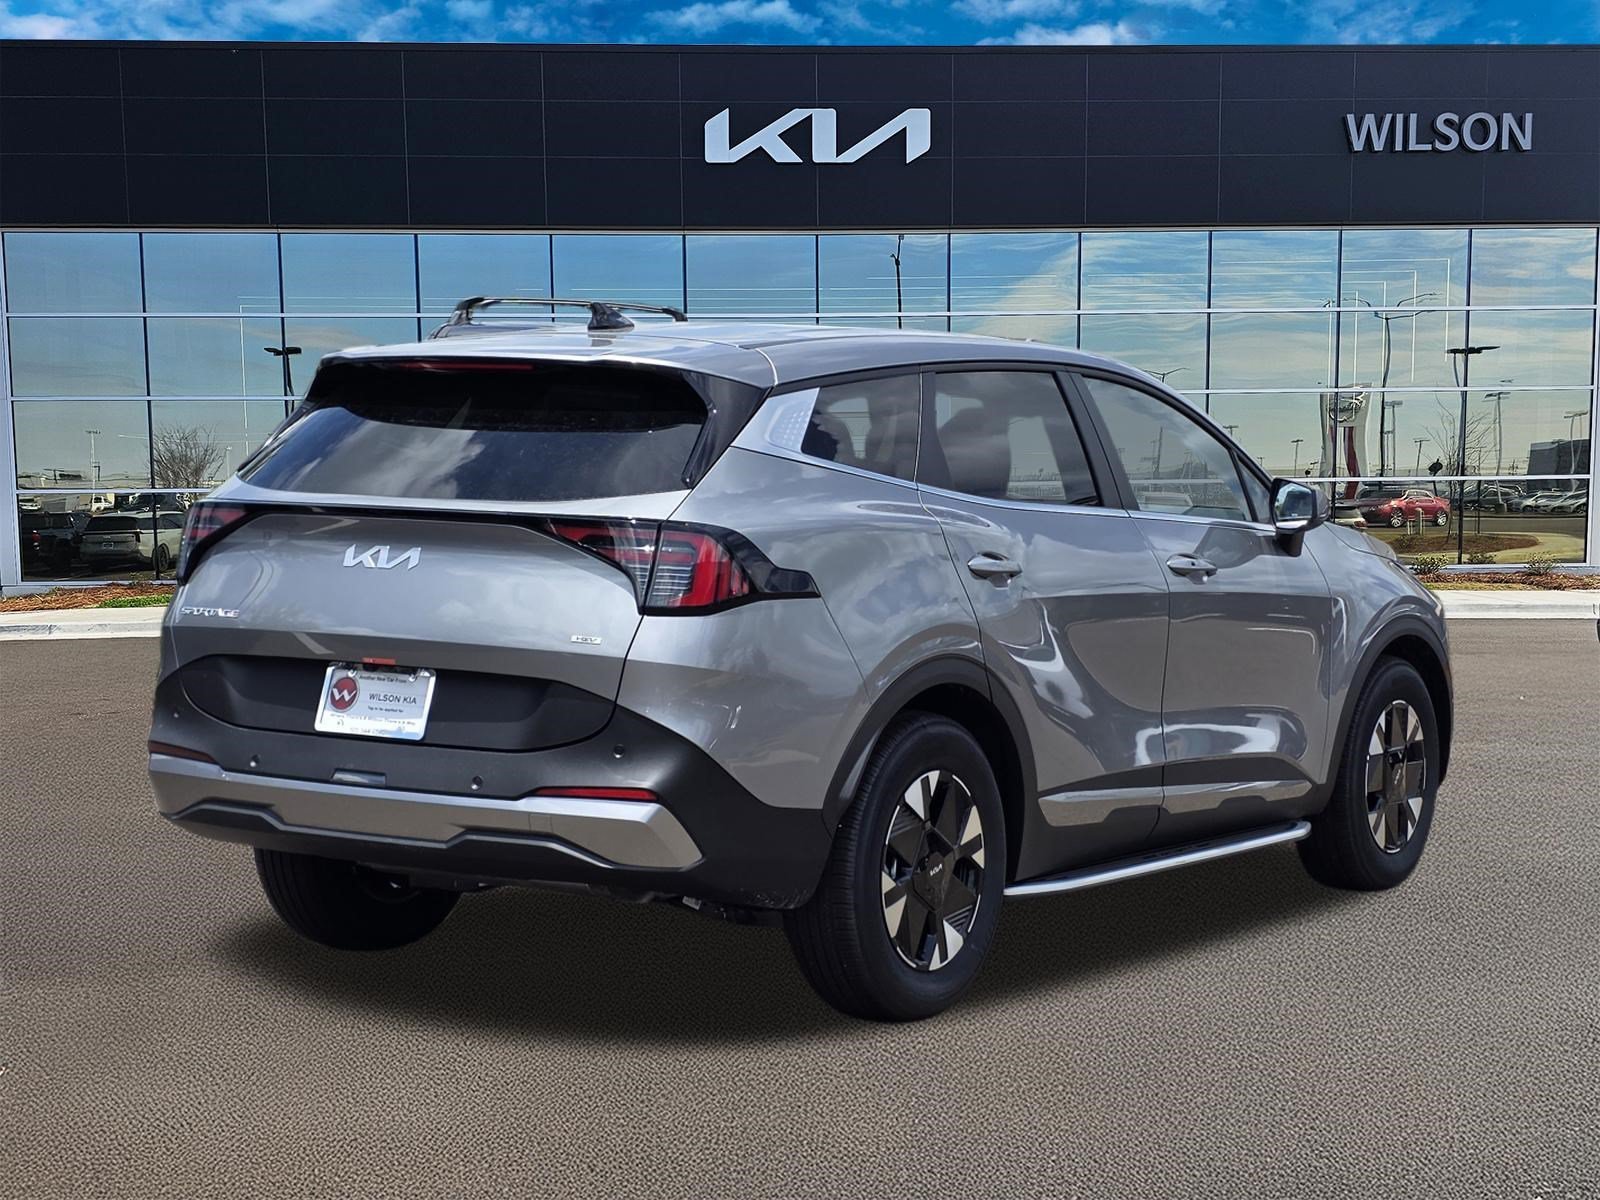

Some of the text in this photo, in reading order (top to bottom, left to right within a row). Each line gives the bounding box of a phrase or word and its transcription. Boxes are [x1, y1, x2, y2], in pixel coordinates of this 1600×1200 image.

[704, 107, 931, 164] KIA
[1346, 111, 1533, 152] WILSON
[343, 543, 421, 570] KIA
[368, 692, 417, 705] WILSON KIA
